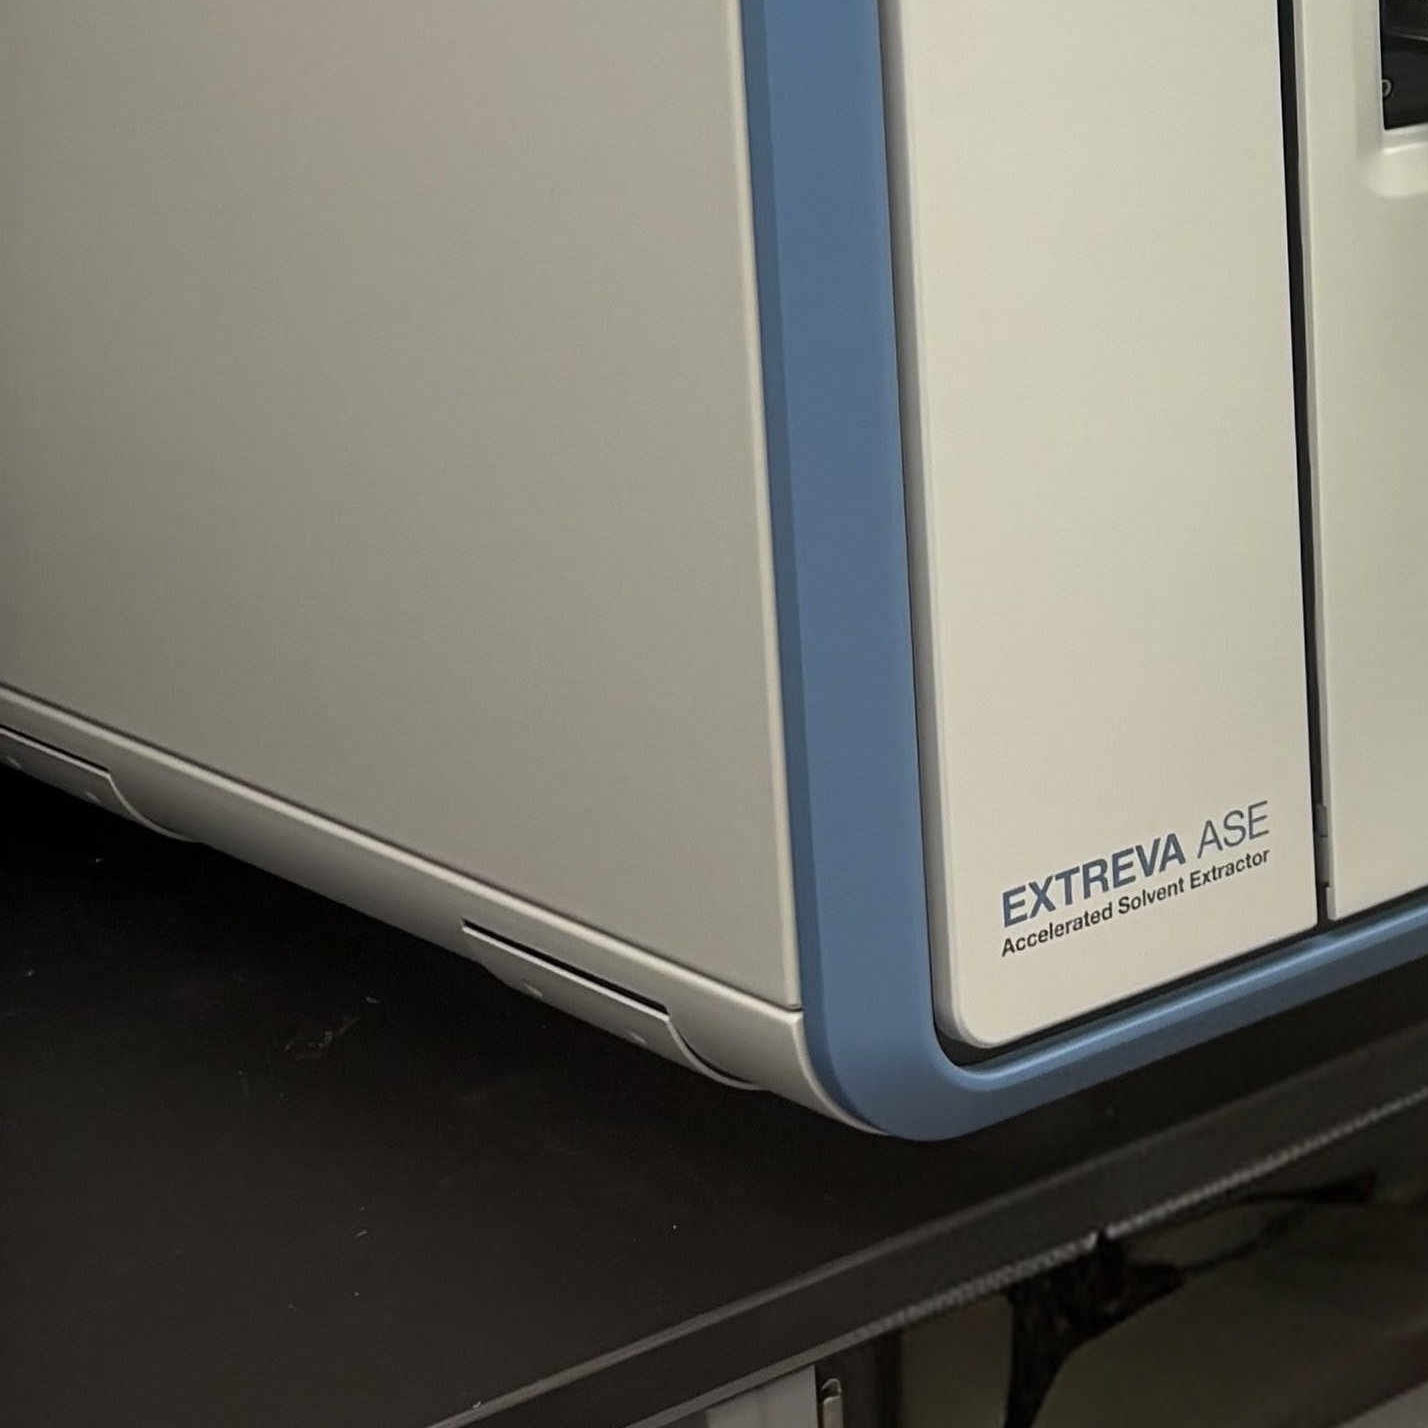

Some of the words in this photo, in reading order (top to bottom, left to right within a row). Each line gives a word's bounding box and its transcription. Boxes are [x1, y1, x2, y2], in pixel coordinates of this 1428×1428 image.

[1001, 901, 1113, 957] Accelerated
[1118, 877, 1185, 915] Solvent
[1189, 849, 1271, 890] Extractor
[1002, 832, 1186, 928] EXTREVA
[1197, 800, 1270, 860] ASE
